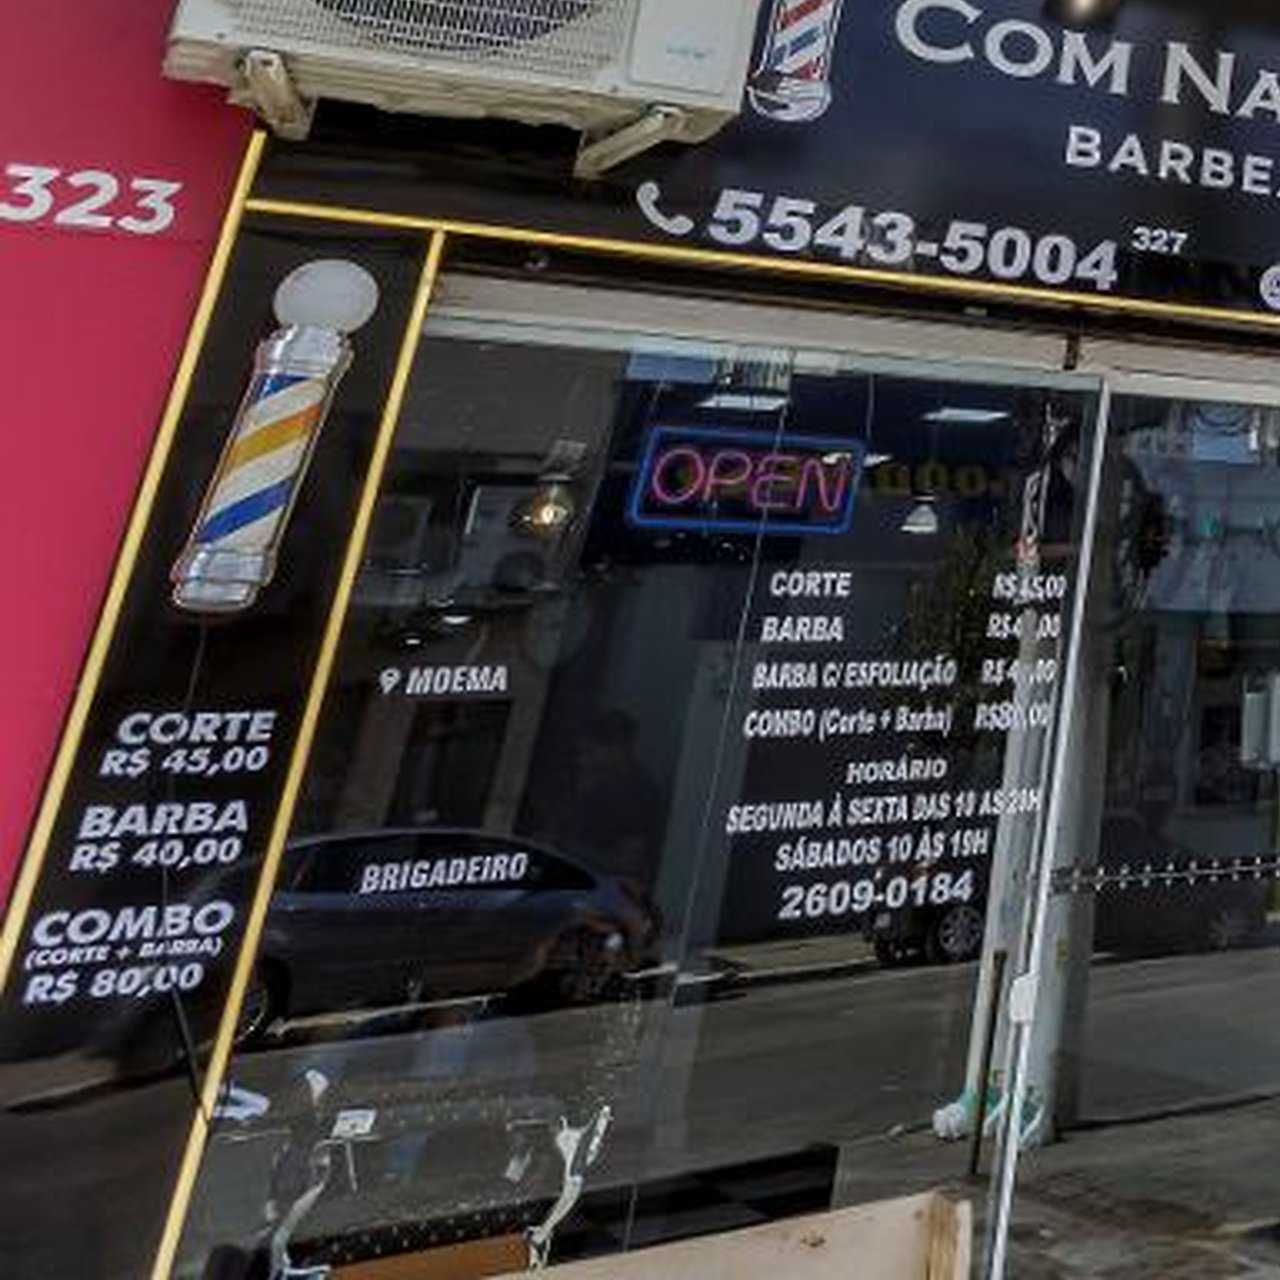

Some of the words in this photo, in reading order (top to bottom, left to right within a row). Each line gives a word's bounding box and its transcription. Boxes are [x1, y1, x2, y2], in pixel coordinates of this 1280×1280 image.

[0, 164, 183, 235] 323
[706, 187, 1119, 291] 5543-5004
[1132, 224, 1188, 257] 327
[651, 448, 855, 512] OPEN
[769, 571, 852, 597] CORTE
[760, 615, 844, 642] BARBA
[405, 666, 507, 695] MOEMA
[752, 661, 817, 690] BARBA
[116, 710, 277, 746] CORTE
[743, 708, 814, 739] COMBO
[819, 708, 876, 741] (Corte
[100, 747, 151, 778] R$
[162, 745, 269, 776] 45,00
[845, 755, 948, 784] HORÁRIO
[77, 799, 249, 840] BARBA
[725, 800, 823, 835] SEGUNDA
[847, 795, 908, 826] SEXTA
[912, 792, 951, 821] DAS
[69, 840, 121, 873] R$
[132, 837, 243, 870] 40,00
[774, 835, 882, 872] SÁBADOS
[360, 852, 529, 895] BRIGADEIRO
[778, 870, 974, 920] 2609-0184
[31, 900, 235, 947] COMBO
[24, 943, 111, 970] (CORTE
[22, 969, 79, 1005] R$
[90, 962, 204, 999] 80,00
